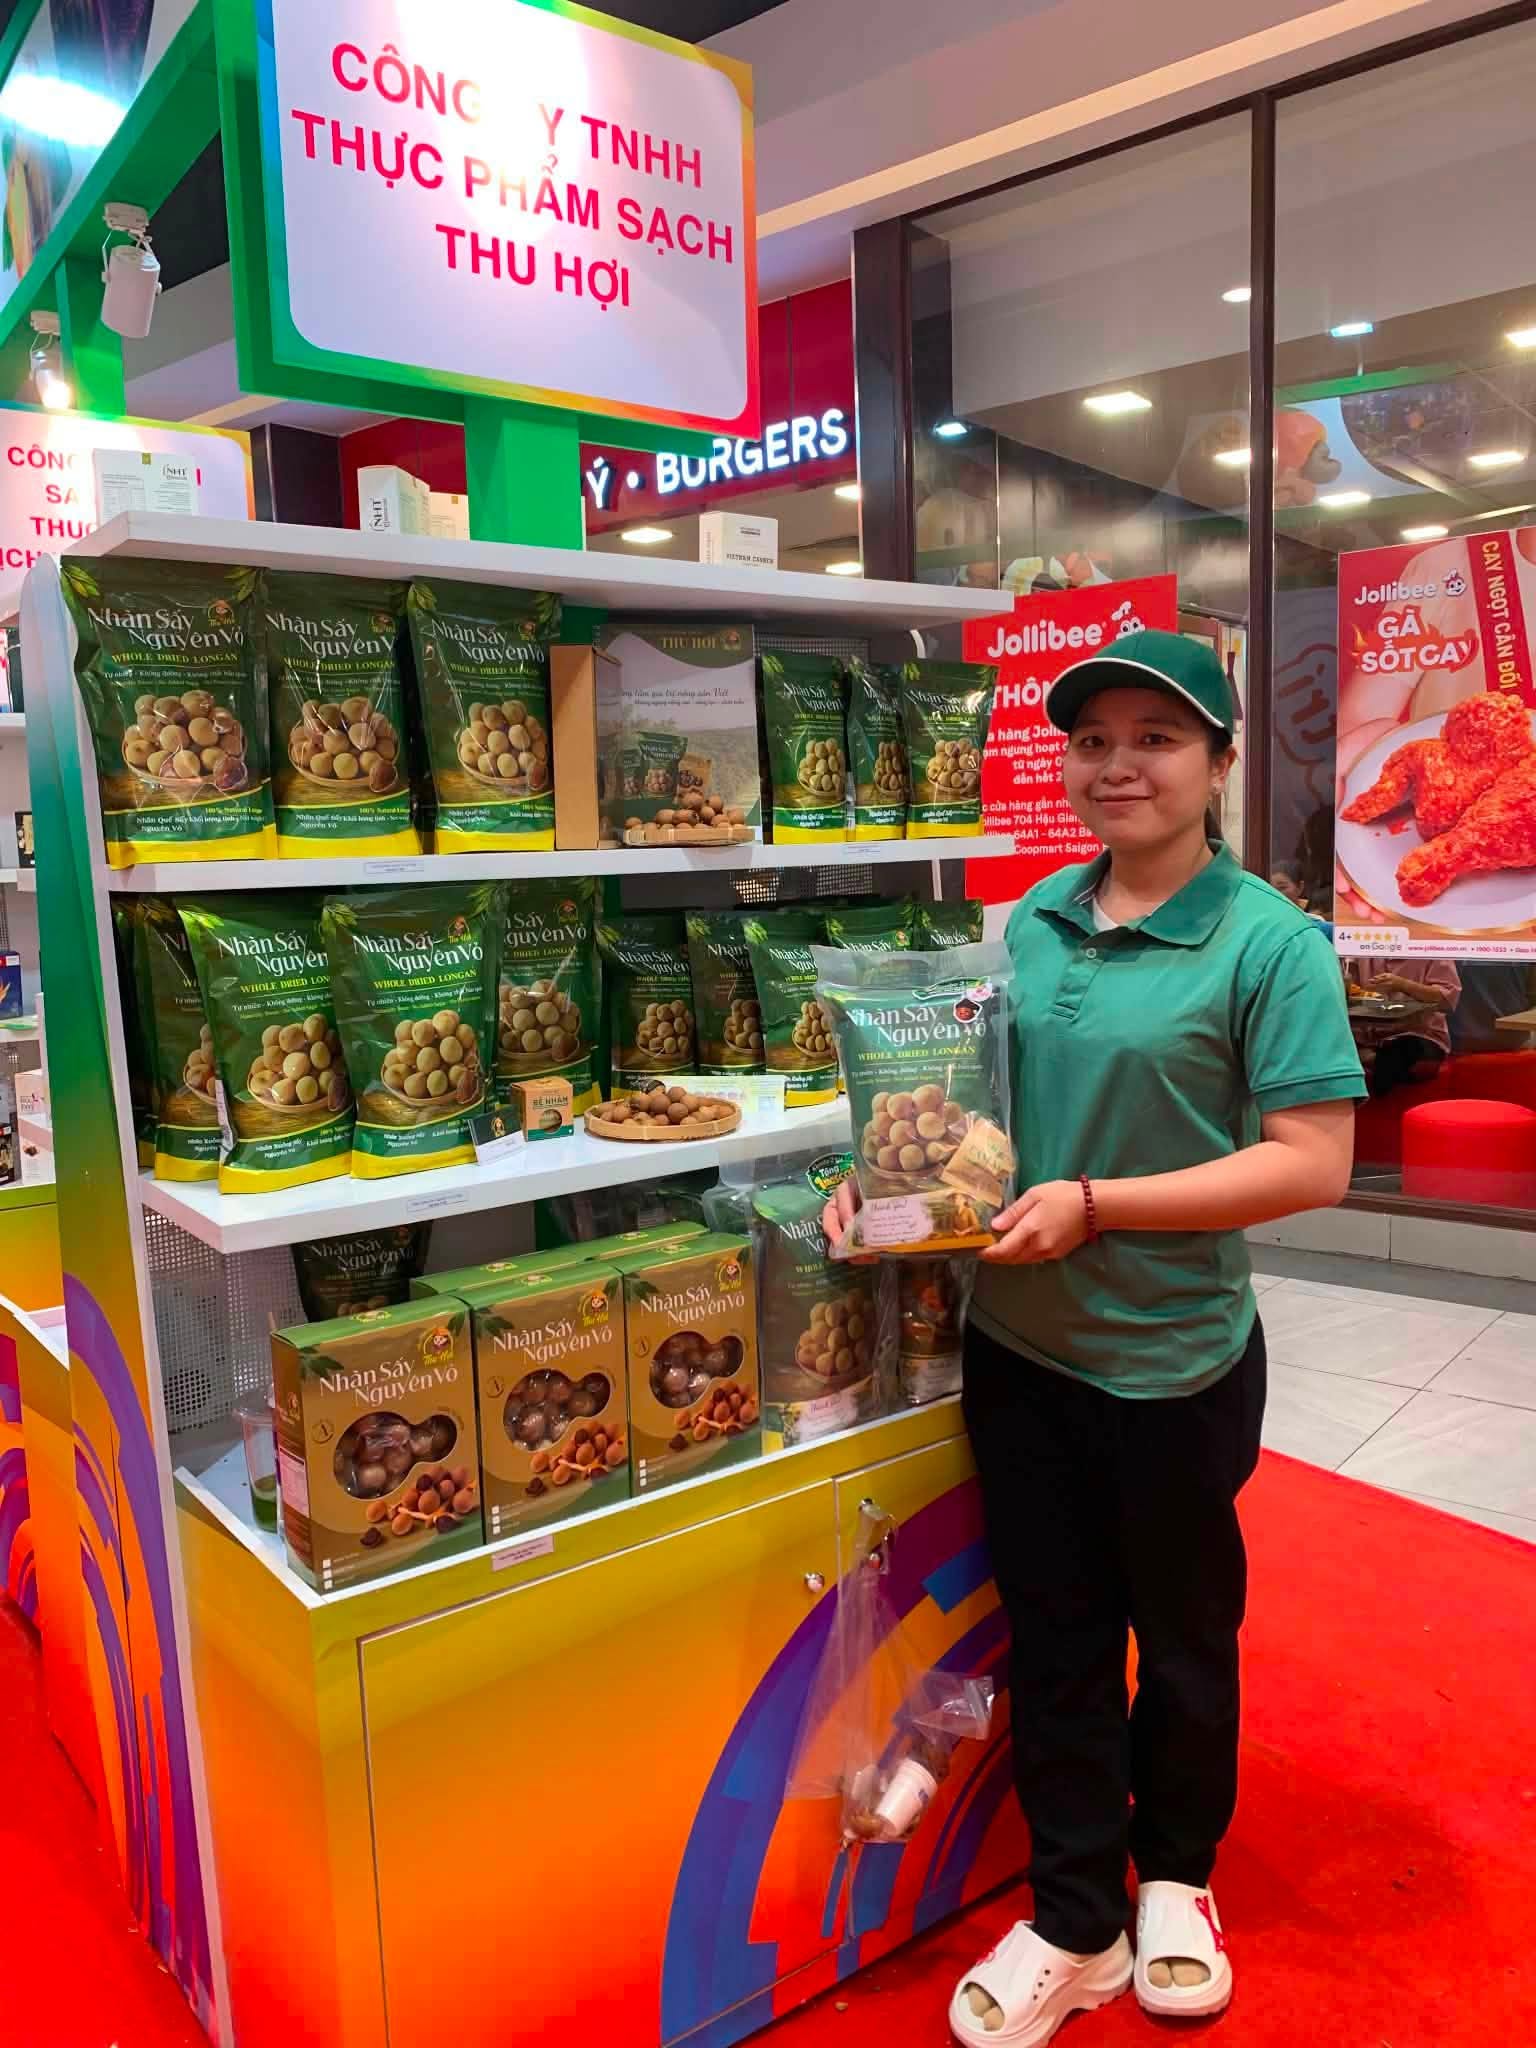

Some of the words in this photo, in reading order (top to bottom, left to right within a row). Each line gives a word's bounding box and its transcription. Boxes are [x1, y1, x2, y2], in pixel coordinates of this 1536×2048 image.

[581, 115, 702, 188] TNHH
[291, 109, 444, 189] THỰC
[463, 153, 601, 230] PHẨM
[617, 197, 734, 263] SẠCH
[436, 224, 536, 286] THU
[555, 251, 630, 311] HỢI
[656, 409, 848, 495] BURGERS
[1482, 540, 1504, 571] CAY
[1354, 581, 1437, 605] Jollibee
[1486, 577, 1510, 619] NGỌT
[987, 619, 1103, 658] Jollibee
[1377, 608, 1421, 639] GÀ
[1493, 623, 1517, 657] CÂN
[112, 652, 153, 664] WHOLE
[157, 653, 190, 664] DRIED
[193, 653, 238, 665] LONGAN
[320, 662, 352, 672] DRIED
[1360, 639, 1416, 672] SỐT
[1419, 638, 1472, 666] CAY
[1065, 842, 1099, 855] Saigon
[274, 929, 308, 952] Sấy
[1371, 941, 1402, 953] Google
[373, 979, 407, 989] WHOLE
[408, 976, 436, 987] DRIED
[438, 968, 478, 983] LONGAN
[384, 949, 460, 975] Nguyên
[240, 982, 278, 993] WHOLE
[280, 977, 308, 988] DRIED
[878, 1022, 960, 1048] Nguyên
[857, 1050, 894, 1061] WHOLE
[896, 1048, 929, 1058] DRIED
[640, 1293, 684, 1317] Nhãn
[686, 1282, 713, 1305] Sấy
[667, 1299, 727, 1328] Nguyên
[726, 1289, 745, 1309] Vỏ
[493, 1329, 542, 1354] Nhãn
[544, 1317, 576, 1339] Sấy
[523, 1334, 591, 1364] Nguyên
[591, 1324, 613, 1344] Vỏ
[319, 1369, 377, 1397] Nhãn
[380, 1356, 415, 1378] Sấy
[354, 1374, 433, 1407] Nguyên
[433, 1363, 459, 1385] Vỏ
